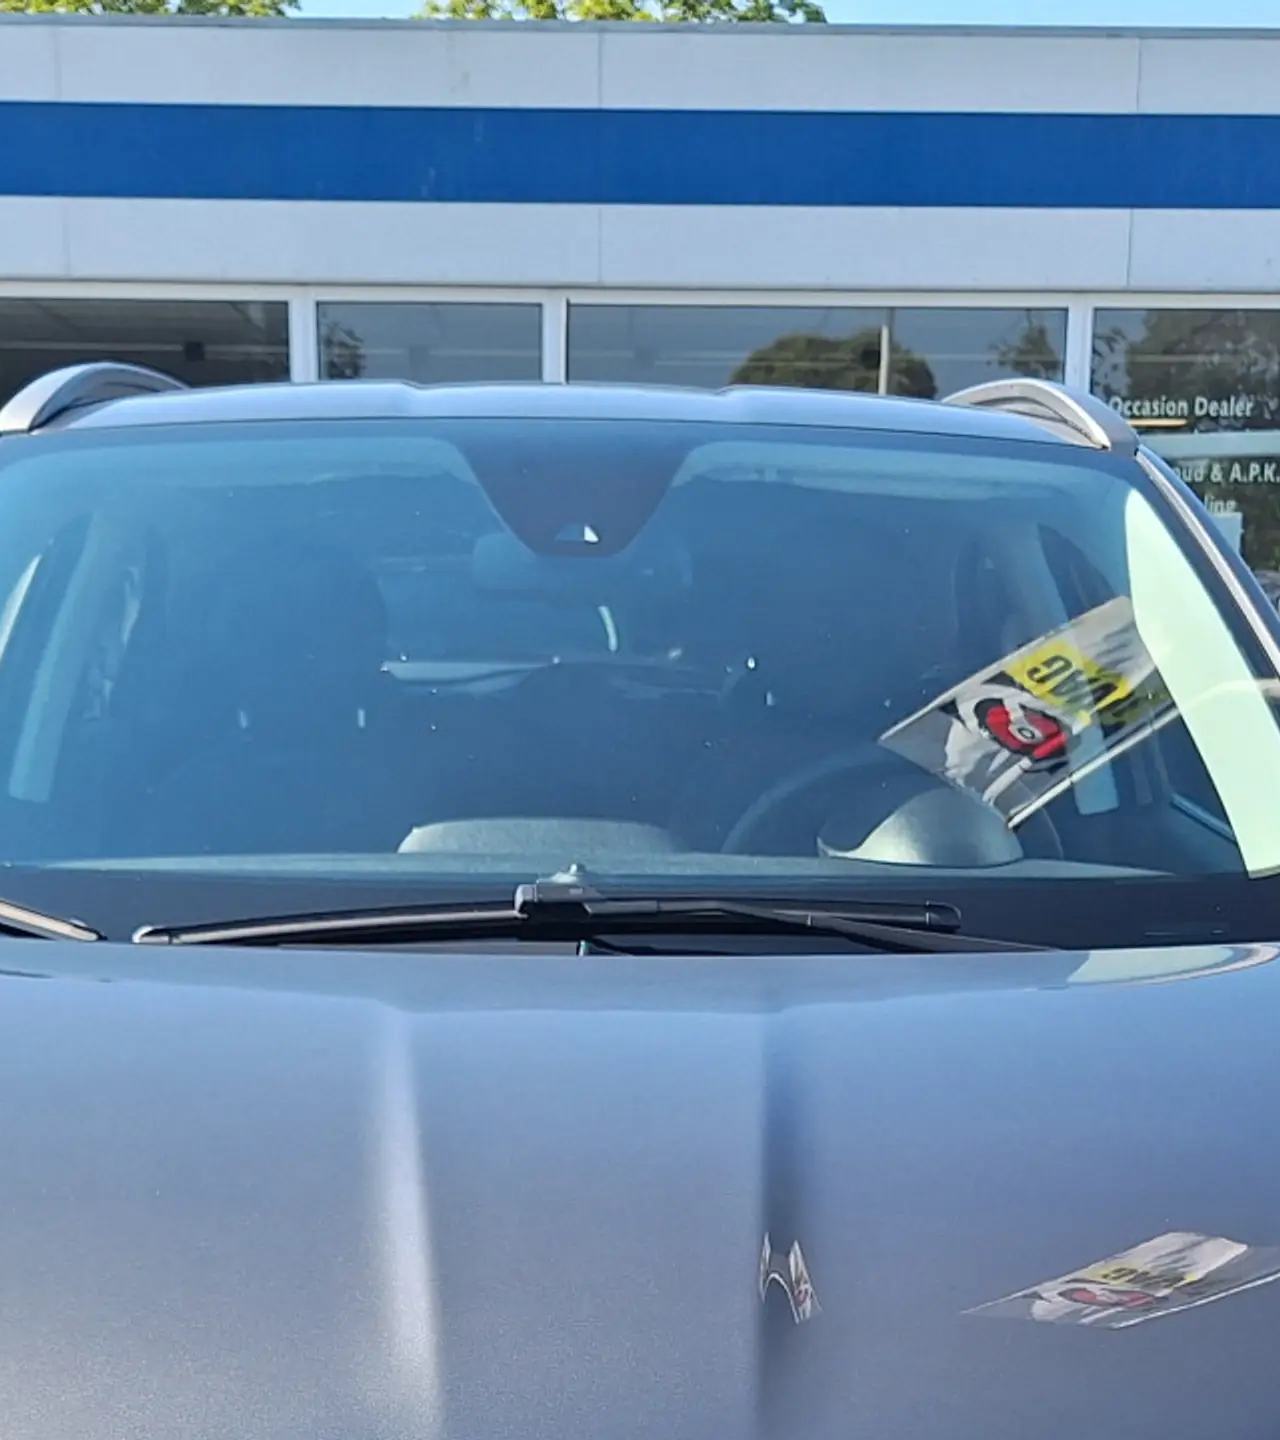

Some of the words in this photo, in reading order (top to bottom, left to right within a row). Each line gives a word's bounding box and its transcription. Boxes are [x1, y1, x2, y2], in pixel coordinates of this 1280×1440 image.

[1109, 395, 1188, 416] Occasion
[1194, 395, 1253, 416] Dealer
[1210, 463, 1223, 482] &
